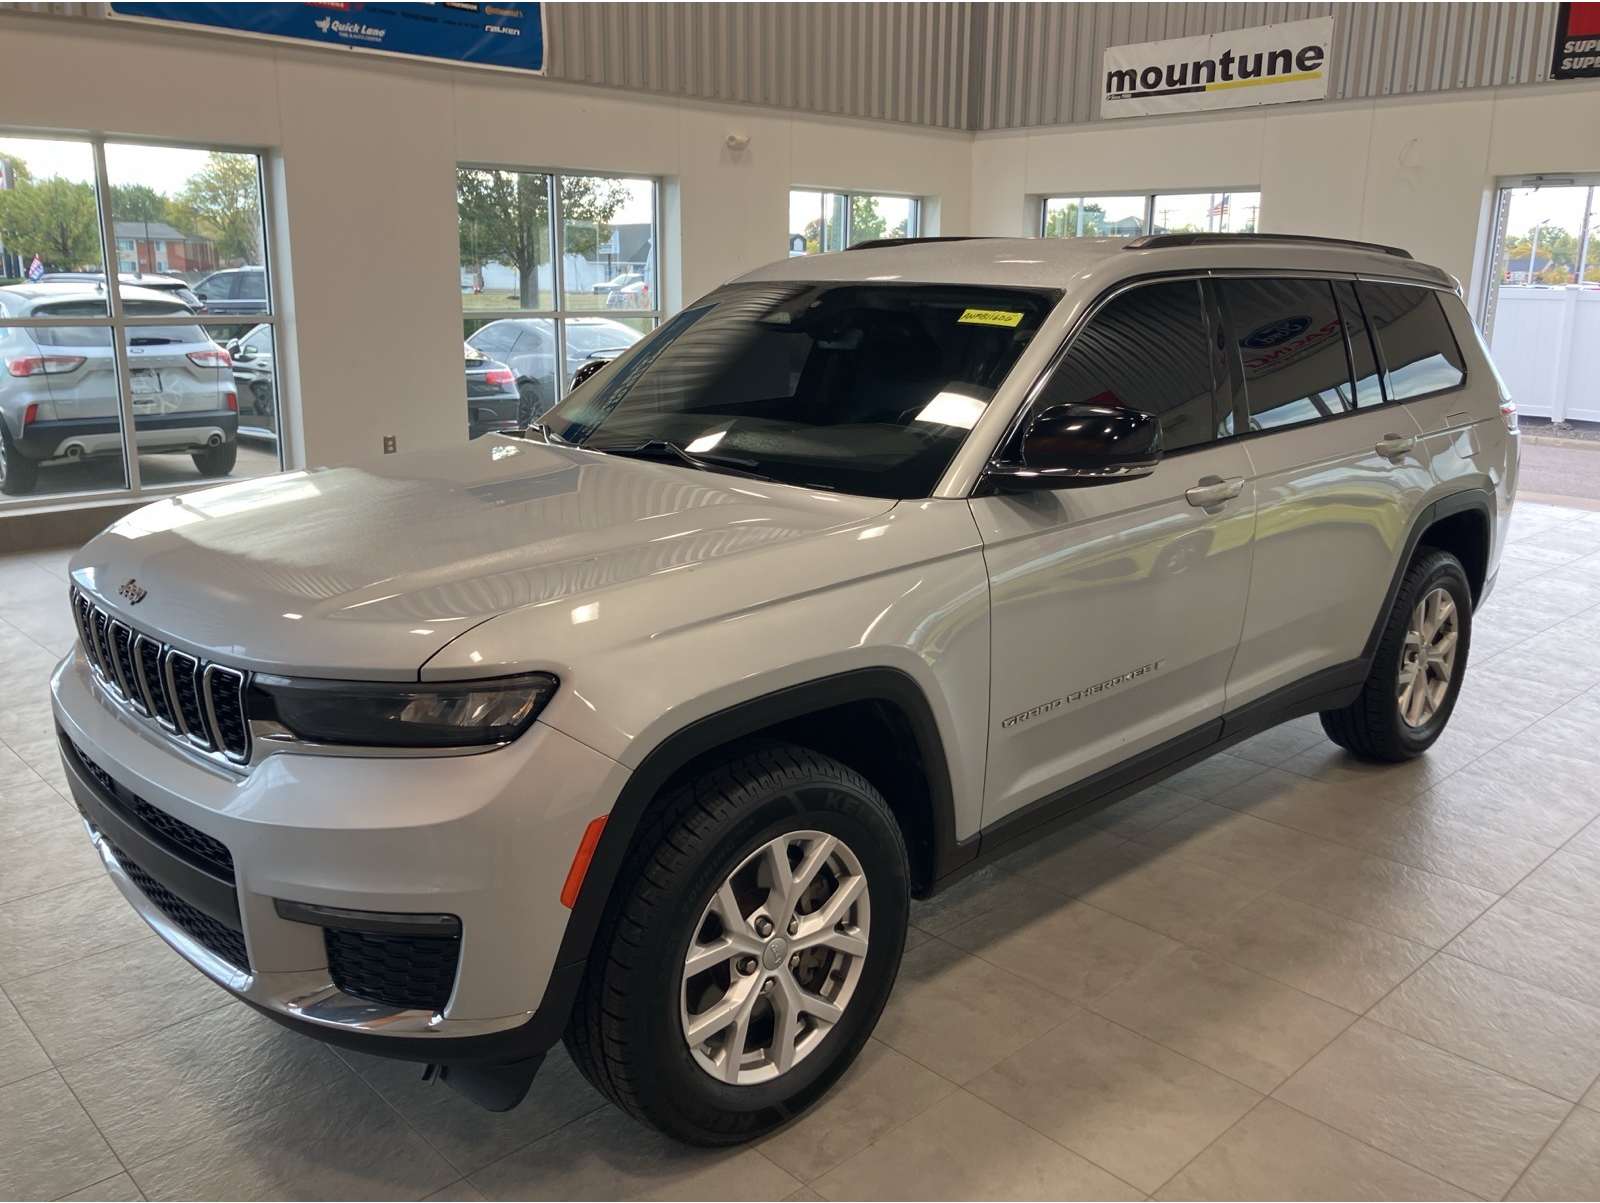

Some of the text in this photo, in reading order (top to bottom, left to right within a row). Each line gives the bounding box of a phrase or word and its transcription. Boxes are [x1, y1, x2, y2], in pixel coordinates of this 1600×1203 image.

[331, 20, 360, 34] Quick
[361, 24, 386, 38] Lane
[1106, 44, 1325, 94] mountune
[1002, 657, 1166, 729] GRAND CHEROKEE
